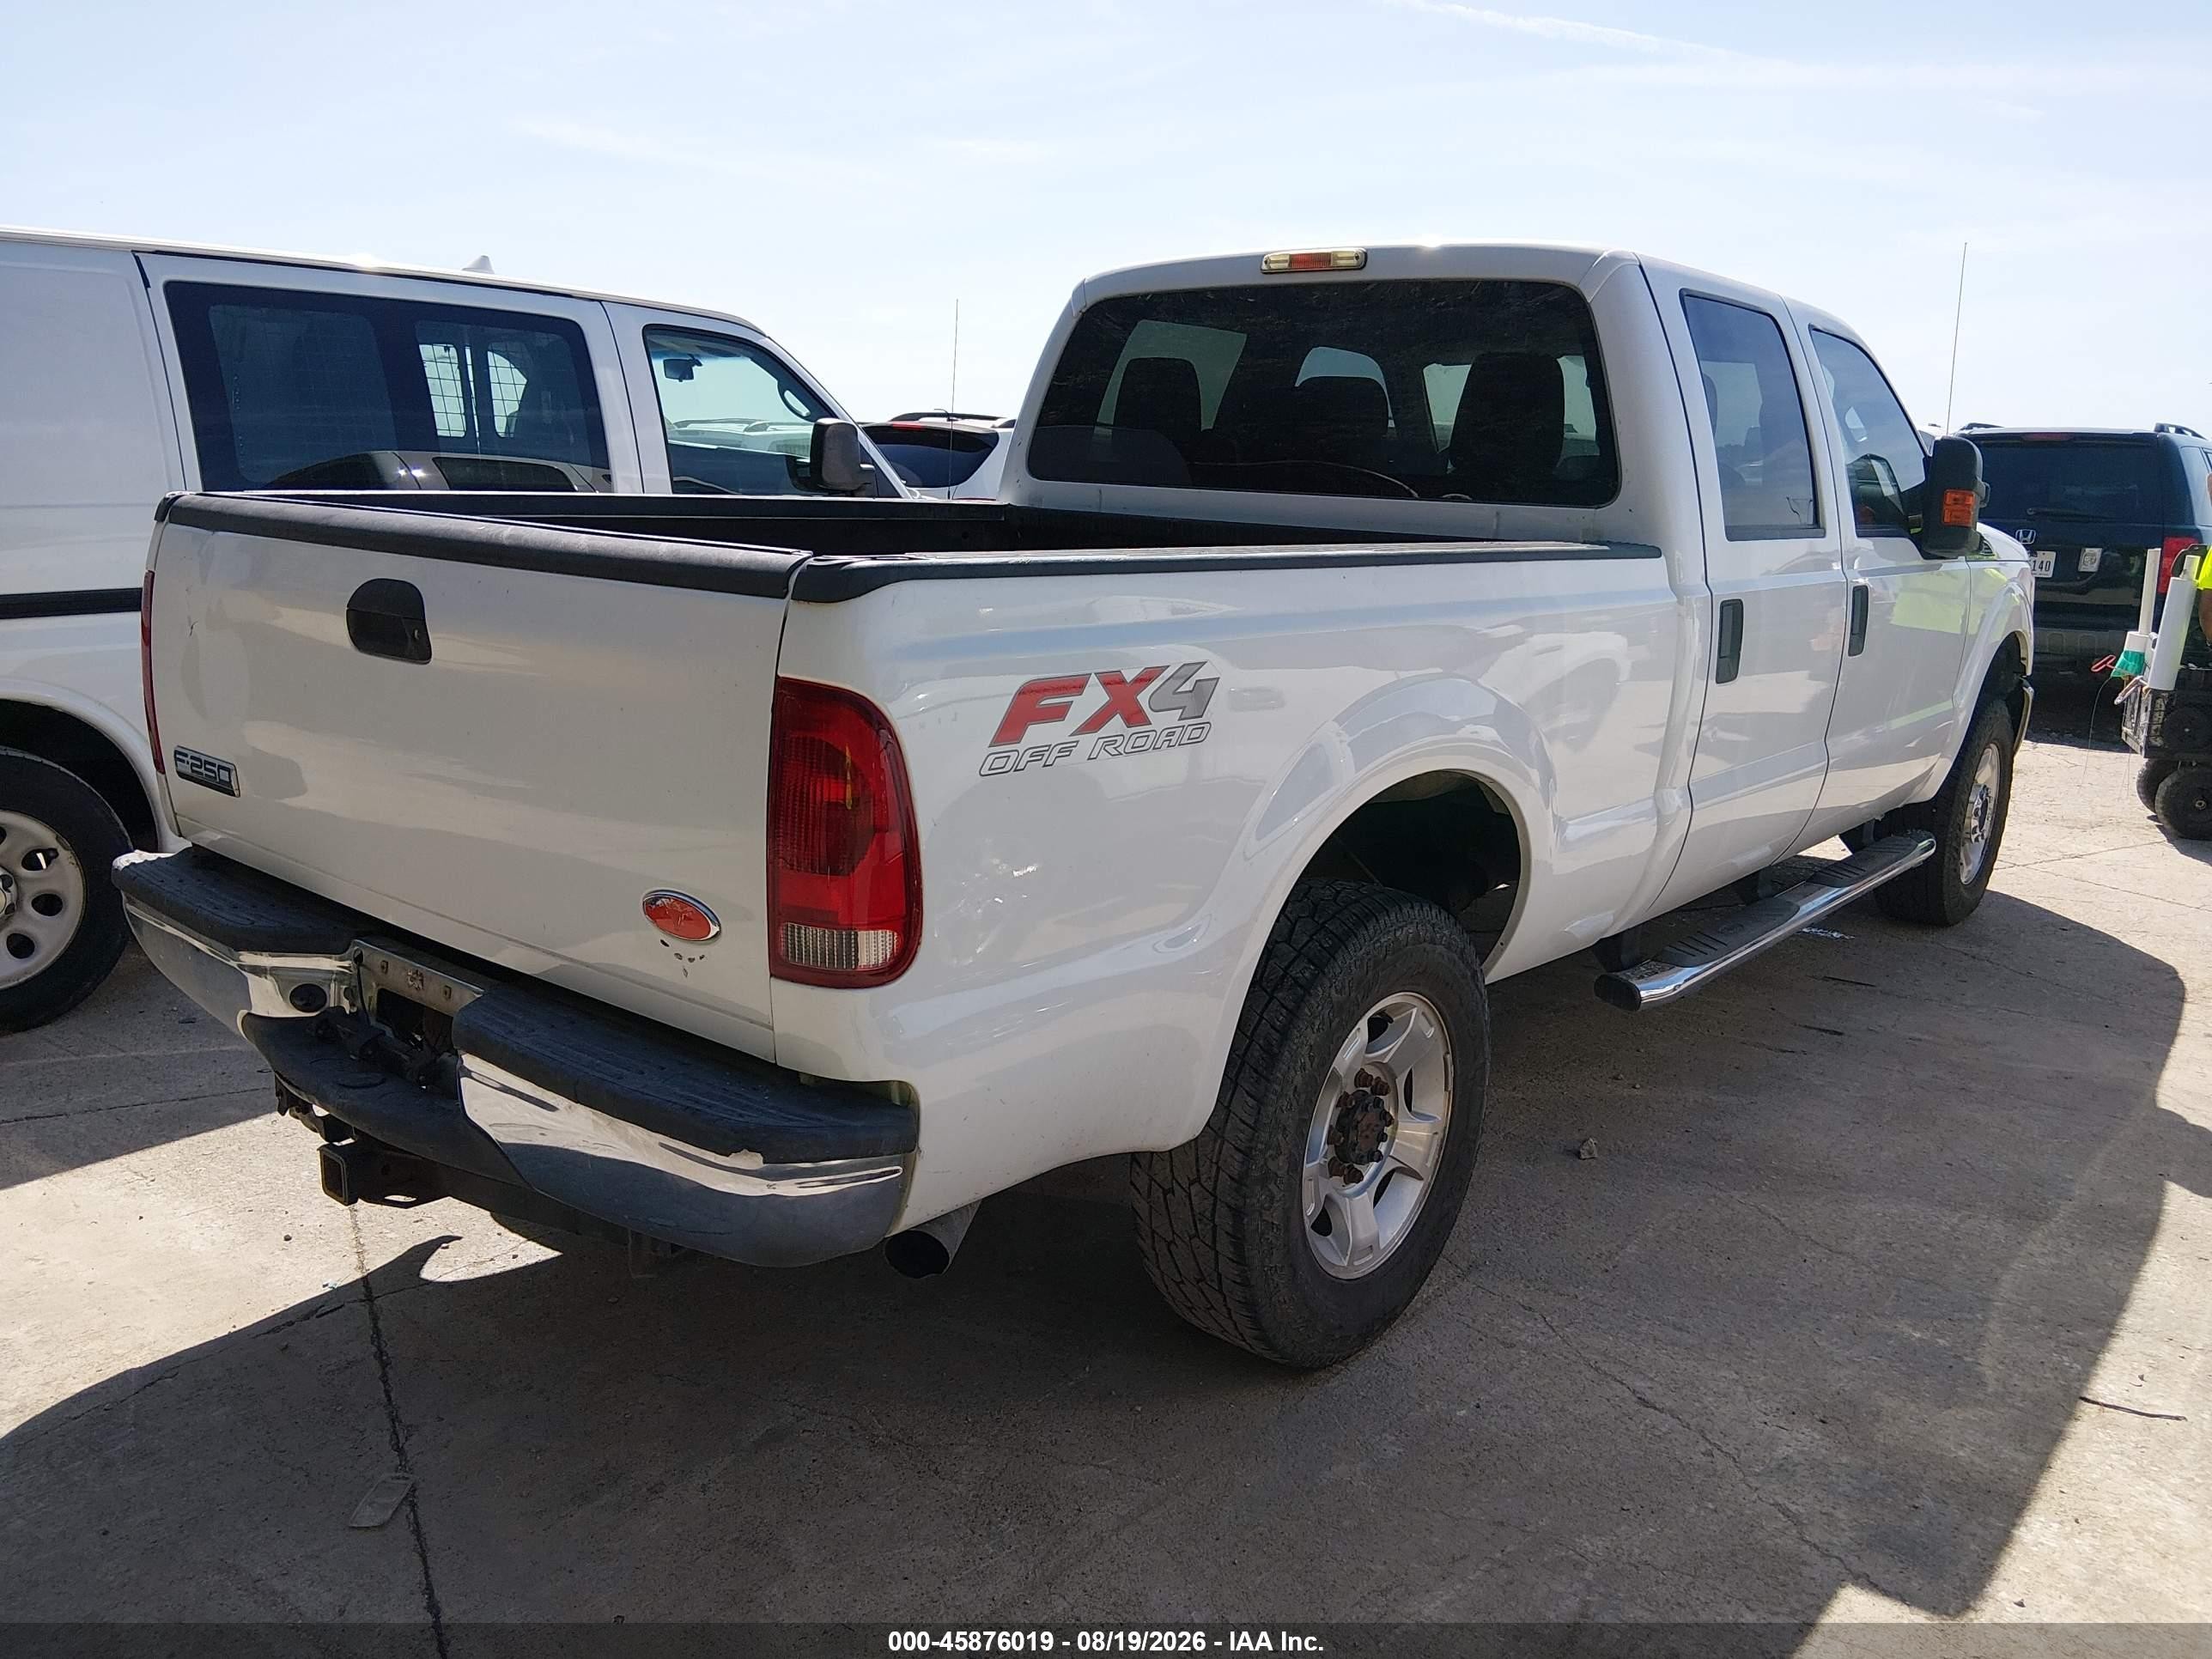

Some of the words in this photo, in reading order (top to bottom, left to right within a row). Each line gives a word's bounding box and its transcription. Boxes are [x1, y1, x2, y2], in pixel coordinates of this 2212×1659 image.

[988, 660, 1220, 748] FX4
[979, 739, 1079, 776] OFF
[1087, 722, 1212, 761] ROAD
